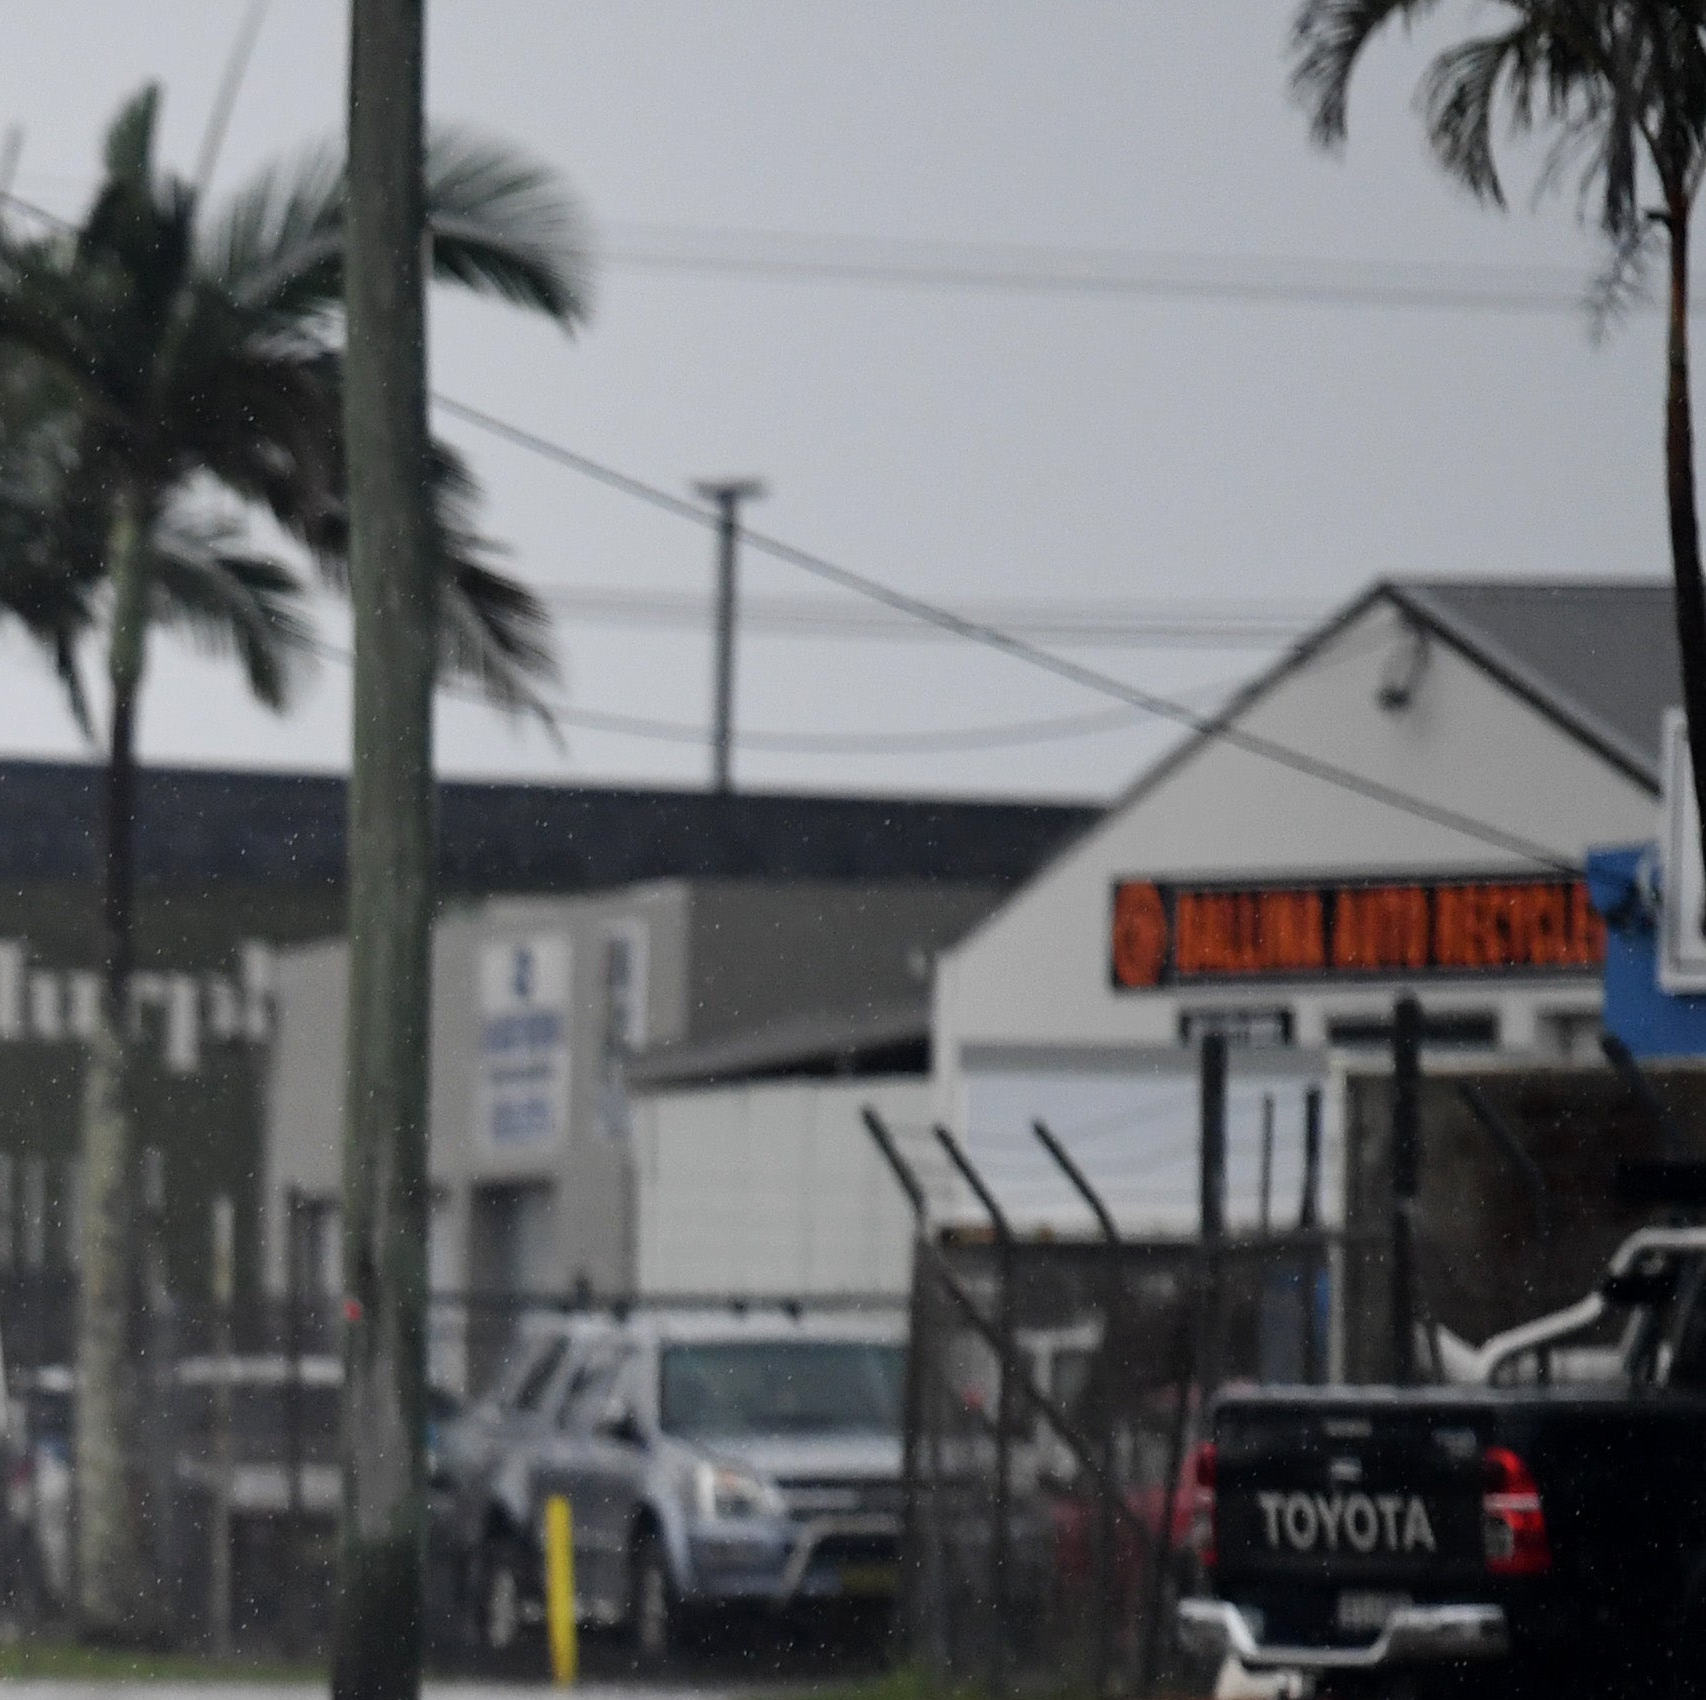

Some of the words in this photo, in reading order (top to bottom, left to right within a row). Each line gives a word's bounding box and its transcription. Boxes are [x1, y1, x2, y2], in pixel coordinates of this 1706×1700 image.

[1176, 892, 1324, 971] BALLINA
[1332, 888, 1428, 968] AUTO
[1258, 1493, 1437, 1552] TOYOTA
